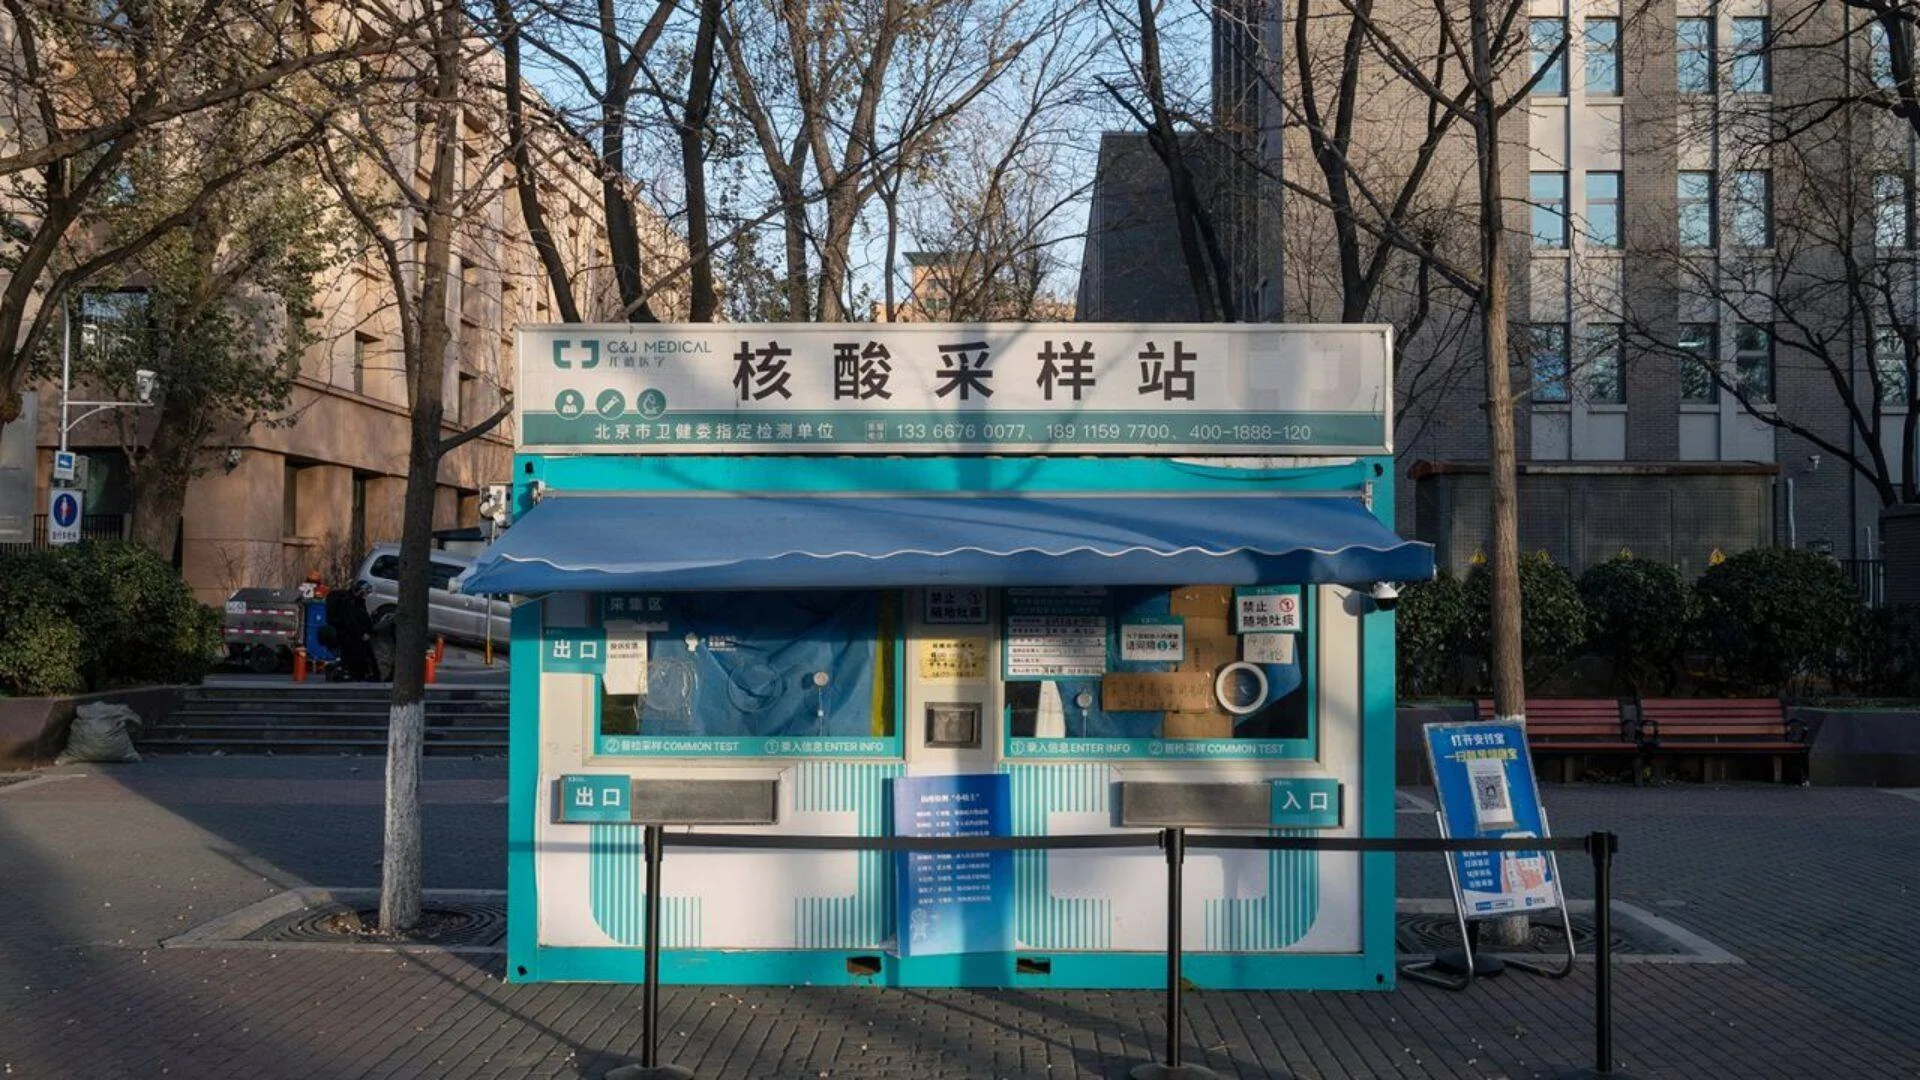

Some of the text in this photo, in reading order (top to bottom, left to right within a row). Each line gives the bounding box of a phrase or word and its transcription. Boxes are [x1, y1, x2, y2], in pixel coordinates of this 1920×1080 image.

[607, 341, 712, 354] C&J MEDICAL
[732, 341, 1197, 401] 核酸采样站
[595, 423, 834, 440] 北京市卫健委指定检测单位
[897, 424, 926, 439] 133
[932, 424, 976, 439] 6676
[1046, 424, 1075, 439] 189
[1084, 424, 1120, 439] 1159
[1189, 424, 1311, 440] 400-1888-120
[1242, 600, 1268, 613] 禁止
[1242, 614, 1294, 627] 随地吐痰
[553, 639, 597, 659] 出口
[663, 741, 712, 752] COMMON
[714, 741, 739, 752] TEST
[824, 741, 858, 752] ENTER
[860, 741, 884, 752] INFO
[1071, 743, 1105, 753] ENTER
[1107, 743, 1131, 753] INFO
[1207, 743, 1257, 755] COMMON
[1259, 743, 1284, 755] TEST
[575, 786, 620, 807] 出口
[1282, 790, 1328, 811] 入口
